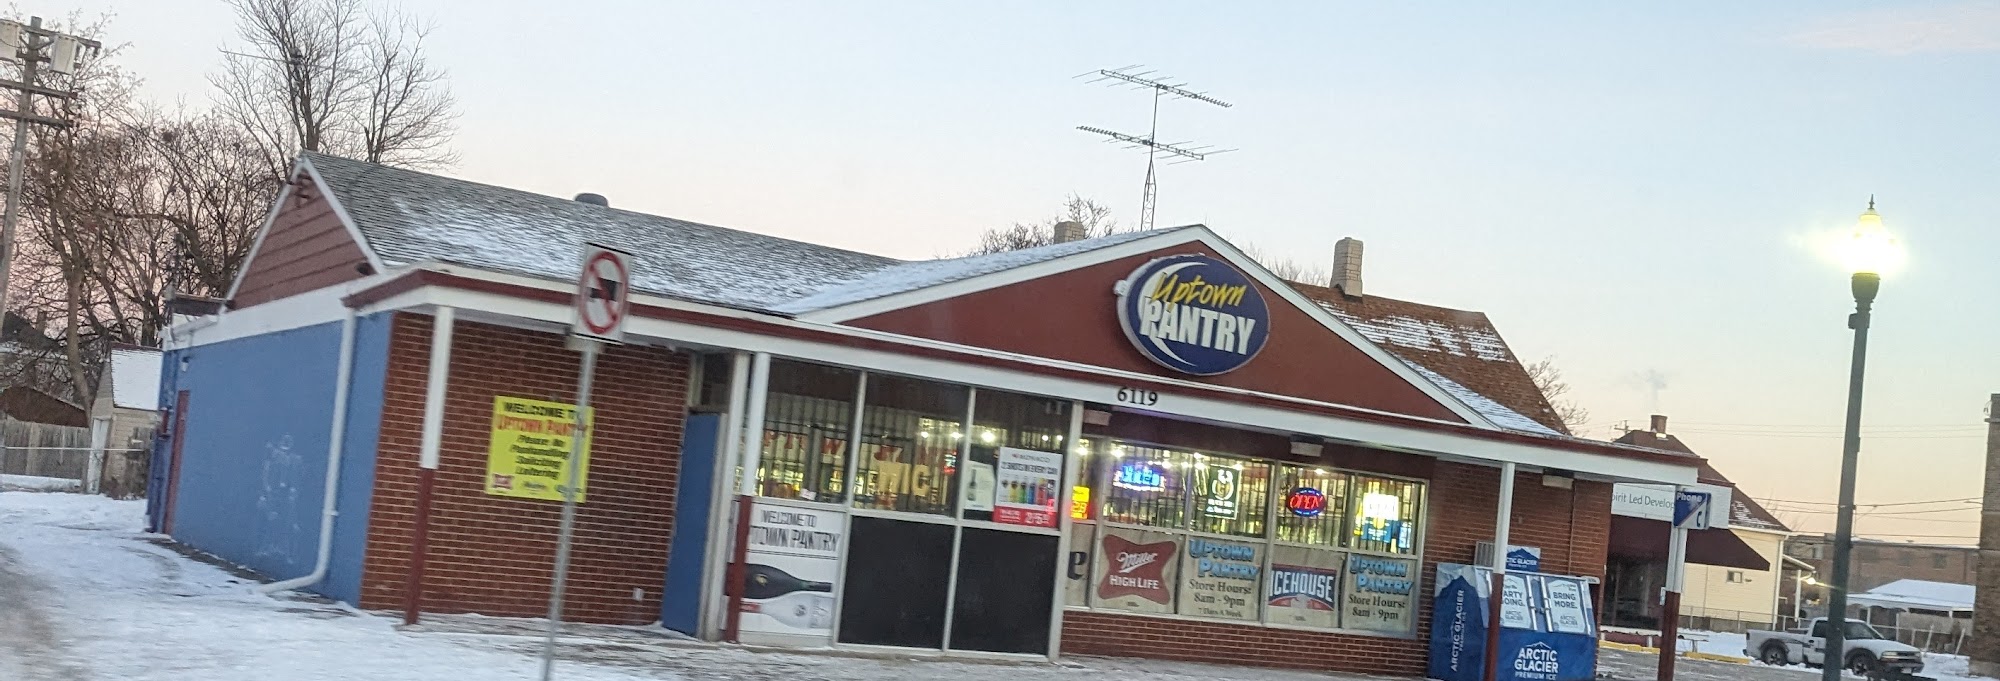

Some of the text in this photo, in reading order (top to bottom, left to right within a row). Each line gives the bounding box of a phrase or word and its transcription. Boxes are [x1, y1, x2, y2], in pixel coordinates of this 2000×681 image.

[1149, 272, 1247, 312] Uptown
[1140, 297, 1256, 355] PANTRY
[1117, 387, 1158, 406] 6119
[504, 402, 564, 419] WELCOME
[1289, 494, 1324, 510] OPEN
[1629, 494, 1643, 505] Led
[1677, 493, 1703, 502] Phone
[760, 510, 818, 528] WELCOME TO
[750, 525, 841, 552] TOWN PANTRY
[1189, 537, 1255, 561] UPTOWN
[1116, 551, 1158, 574] Miller
[1198, 557, 1260, 580] PANTRY
[1350, 554, 1408, 578] UPTOWN
[1506, 557, 1537, 566] CTIC GLACIER
[1110, 575, 1160, 590] HIGH LIFE
[1189, 578, 1252, 595] Store Hours:
[1269, 570, 1335, 603] ICEHOUSE
[1356, 574, 1414, 595] PANTRY
[1194, 592, 1215, 604] 8am
[1223, 594, 1246, 609] 9pm
[1349, 594, 1406, 609] Store Hours:
[1503, 591, 1523, 600] ARTY
[1503, 598, 1526, 607] OING.
[1553, 592, 1576, 601] BRING
[1554, 601, 1578, 609] MORE.
[1353, 606, 1370, 617] 8am
[1378, 610, 1399, 622] 9pm
[1450, 590, 1464, 672] ARCTIC GLACIER
[1517, 648, 1557, 661] ARCTIC
[1513, 660, 1559, 674] GLACIER
[1515, 672, 1557, 681] PREMIUM ICE
